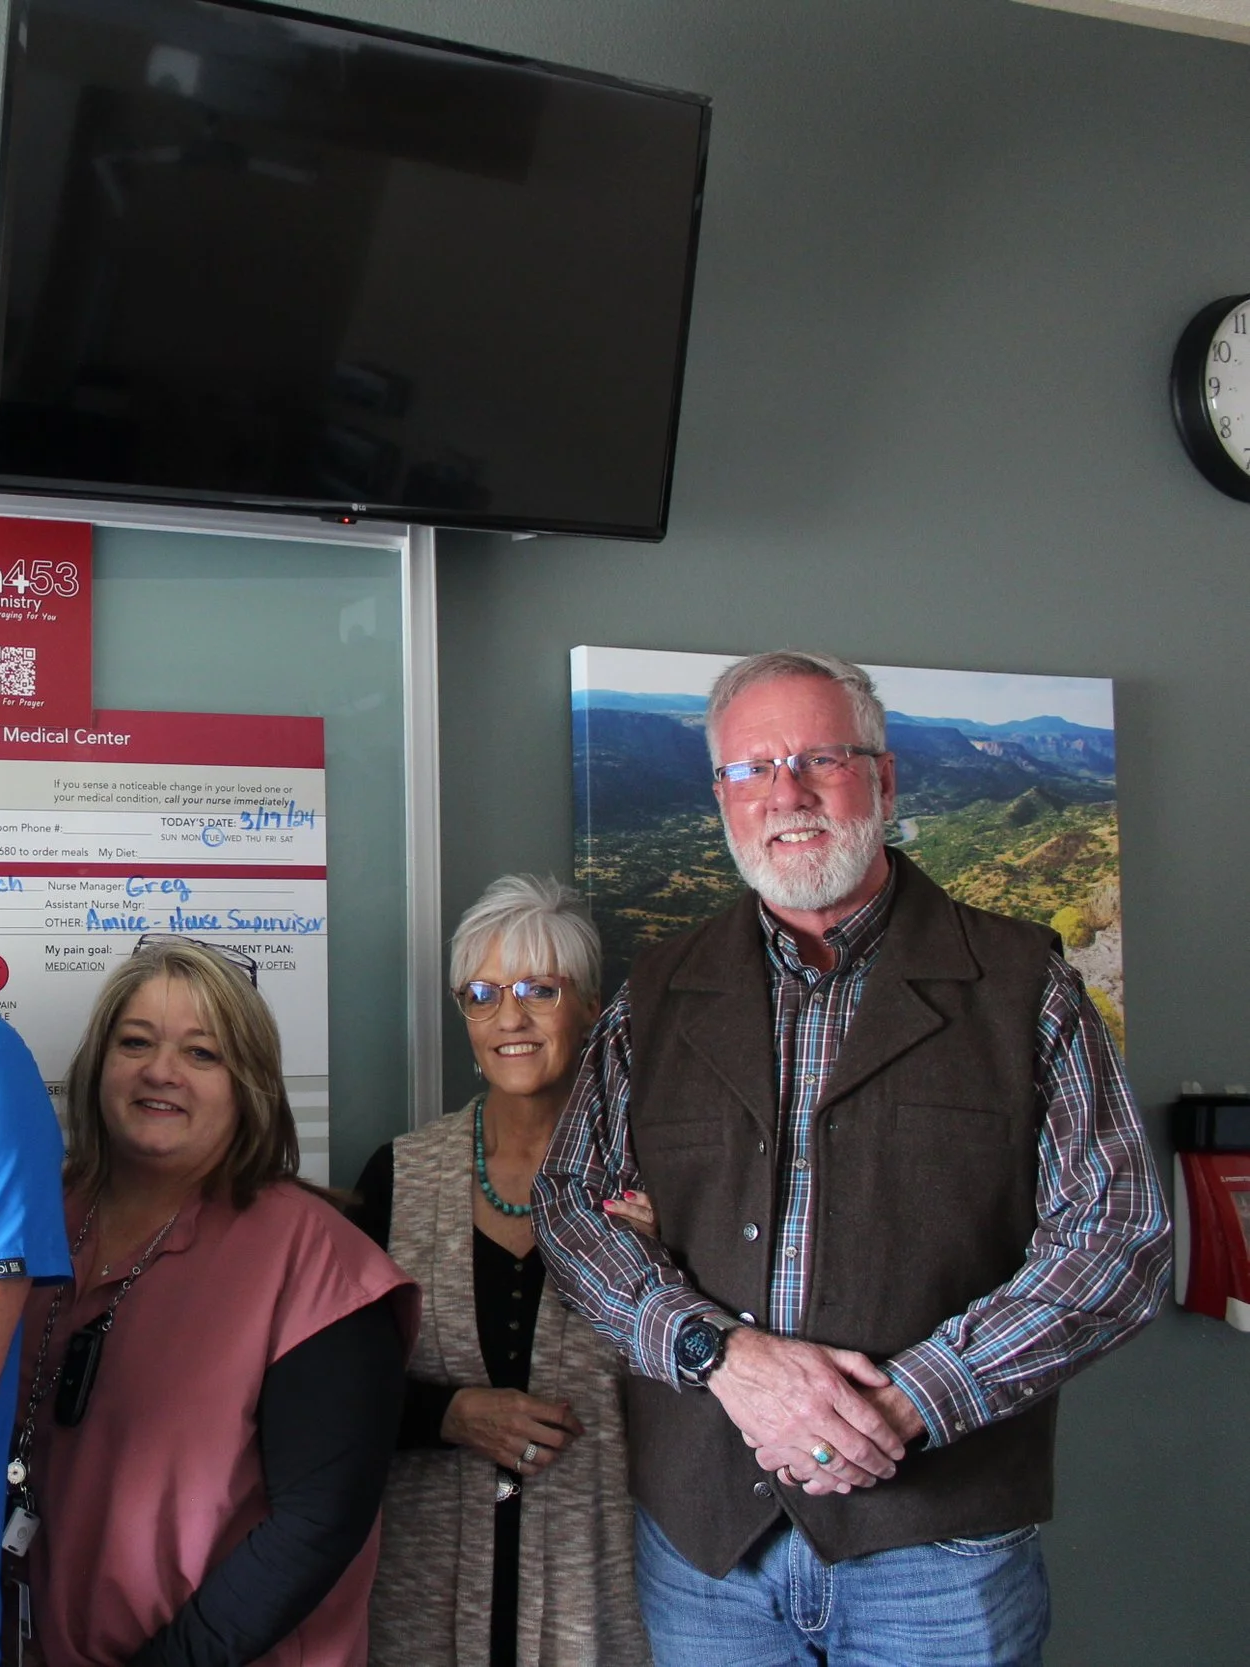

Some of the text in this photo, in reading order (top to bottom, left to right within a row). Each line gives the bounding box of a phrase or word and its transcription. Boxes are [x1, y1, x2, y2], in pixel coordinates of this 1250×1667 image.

[1234, 313, 1247, 334] 11
[1213, 340, 1231, 363] 10
[1209, 377, 1220, 399] 9
[1220, 416, 1232, 439] 8
[42, 612, 57, 621] You
[2, 698, 15, 706] For
[19, 699, 45, 709] Prayer
[4, 727, 68, 744] Medical
[74, 729, 131, 746] Center
[54, 779, 61, 788] If
[62, 782, 80, 791] you
[82, 782, 109, 790] sense
[119, 781, 167, 791] noticeable
[169, 782, 202, 794] change
[204, 783, 213, 792] in
[215, 785, 235, 794] your
[237, 784, 262, 793] loved
[264, 786, 281, 794] one
[54, 793, 75, 803] your
[77, 793, 113, 803] medical
[116, 793, 161, 804] condition,
[164, 794, 180, 804] call
[182, 797, 203, 807] your
[21, 823, 51, 833] Phone
[54, 824, 63, 833] #:
[161, 817, 236, 828] TODAY'S DATE:
[206, 834, 220, 842] TUE
[19, 847, 31, 856] to
[33, 847, 58, 857] order
[61, 848, 89, 857] meals
[98, 848, 138, 859] My Diet:
[48, 881, 124, 893] Nurse Manager:
[125, 875, 191, 902] Greg
[45, 900, 145, 910] Assistant Nurse Mgr:
[45, 918, 84, 927] OTHER:
[227, 908, 326, 933] Supervisor
[45, 945, 112, 957] My pain goal:
[264, 945, 294, 954] PLAN:
[45, 962, 105, 971] MEDICATION
[266, 961, 296, 970] OFTEN
